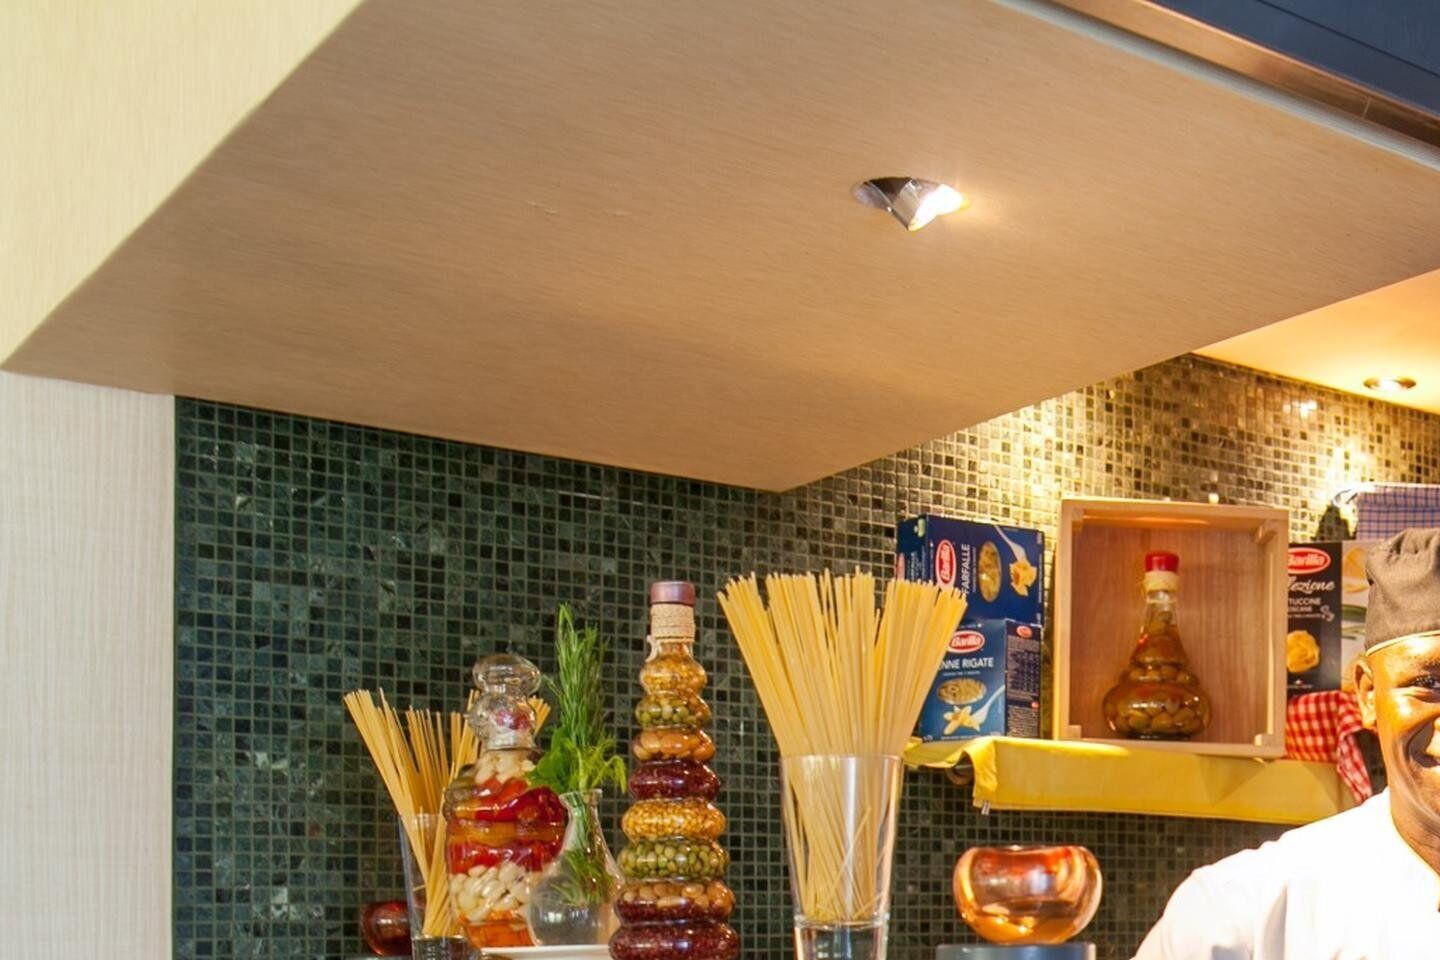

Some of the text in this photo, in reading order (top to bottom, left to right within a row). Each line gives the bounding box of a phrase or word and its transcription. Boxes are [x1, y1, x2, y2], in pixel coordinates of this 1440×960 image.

[940, 542, 950, 582] Barilla
[961, 543, 971, 594] FARFALLE
[951, 636, 981, 647] Barilla
[940, 657, 995, 670] NNE RIGATE
